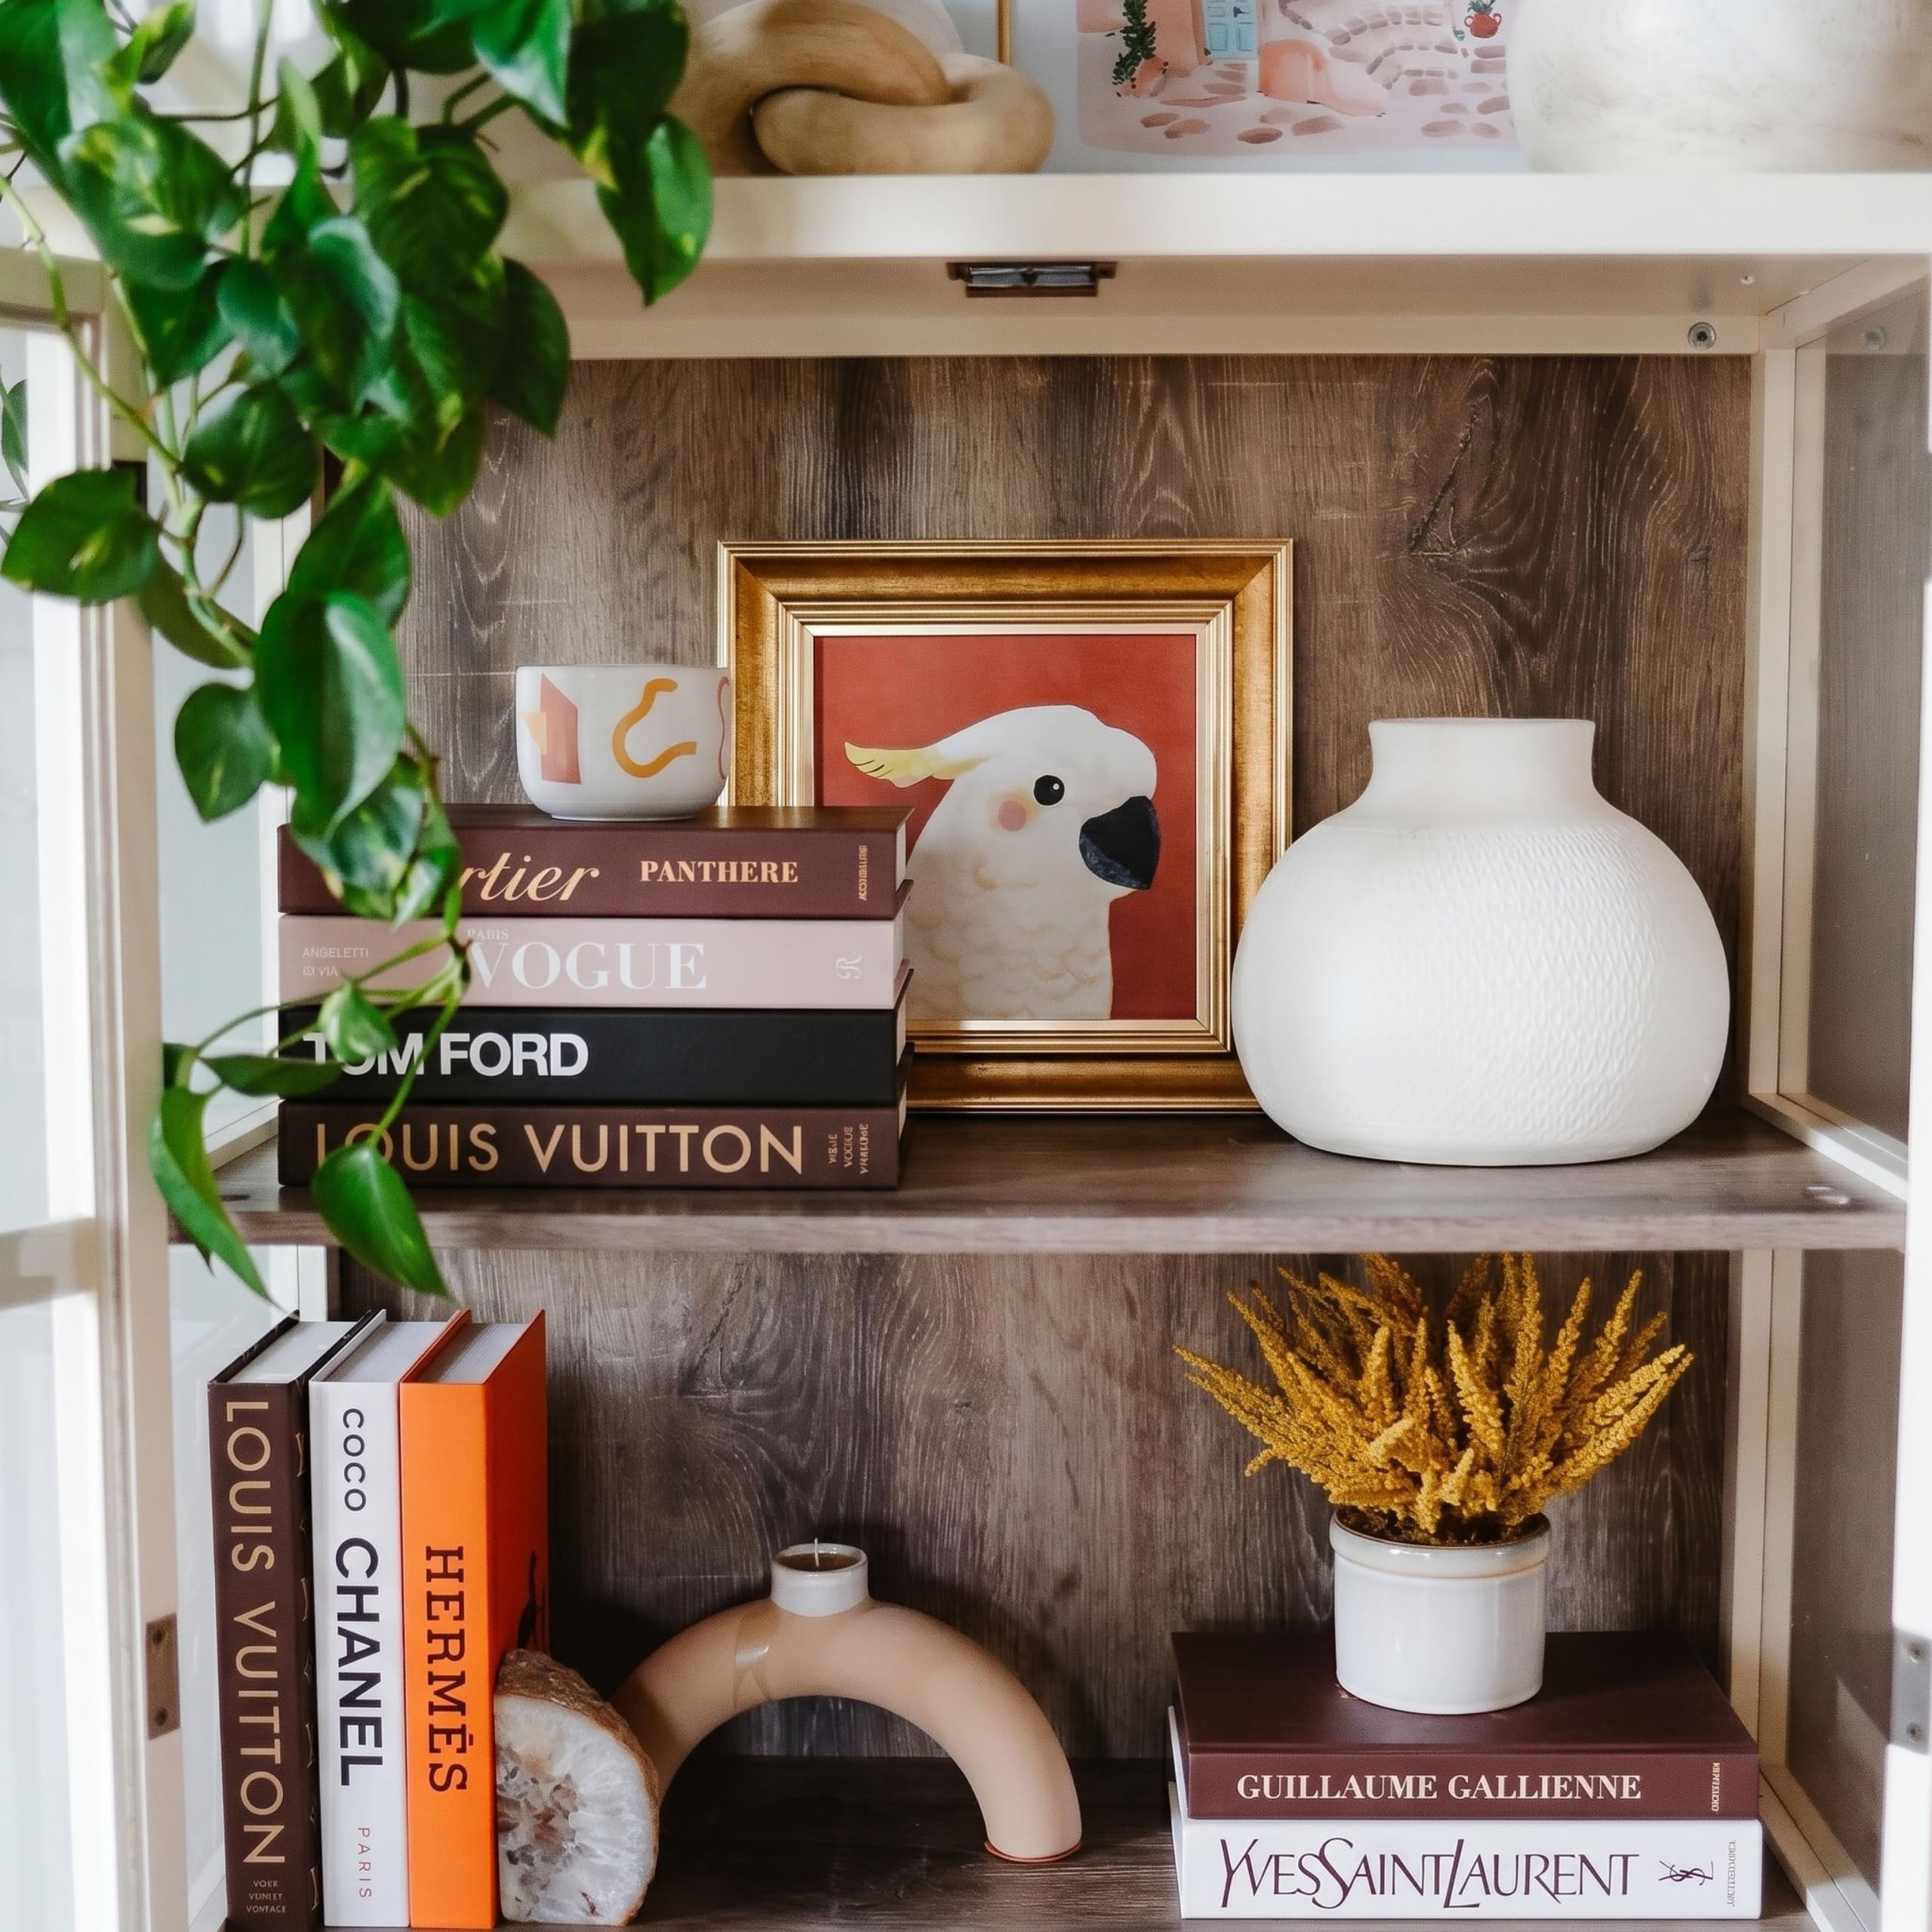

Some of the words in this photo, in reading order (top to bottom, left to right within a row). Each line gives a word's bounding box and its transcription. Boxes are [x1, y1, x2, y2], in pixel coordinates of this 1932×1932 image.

[459, 852, 600, 901] rtier
[640, 860, 799, 883] PANTHERE
[302, 947, 369, 958] ANGELETTI
[471, 941, 707, 990] VOGUE
[440, 1032, 589, 1077] FORD
[523, 1124, 803, 1175] VUITTON
[343, 1407, 367, 1512] COCO
[226, 1401, 275, 1572] LOUIS
[335, 1537, 383, 1786] CHANEL
[233, 1601, 285, 1863] VUITTON
[1237, 1774, 1438, 1799] GUILLAUME
[1447, 1774, 1641, 1799] GALLIENNE
[357, 1827, 372, 1898] PARIS
